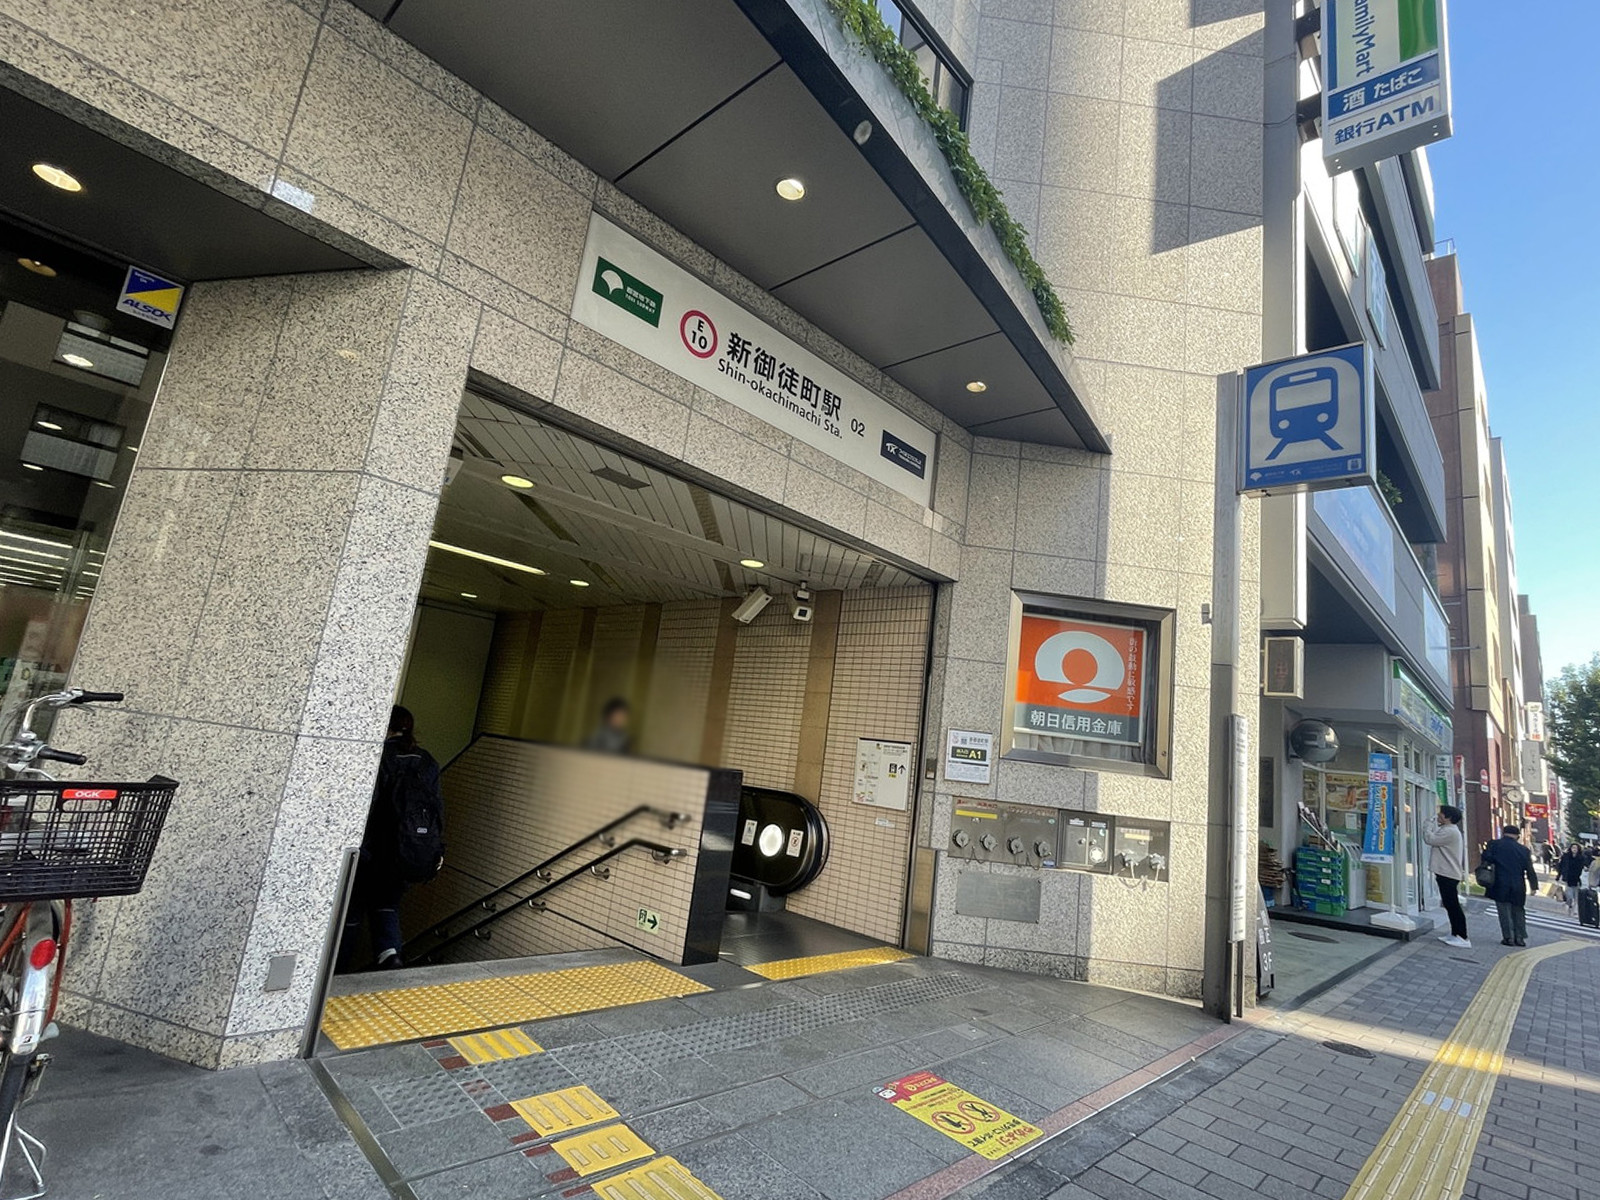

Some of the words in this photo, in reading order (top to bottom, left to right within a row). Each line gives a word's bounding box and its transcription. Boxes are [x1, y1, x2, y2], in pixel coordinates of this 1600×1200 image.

[1343, 87, 1365, 111] 酒
[1374, 67, 1423, 99] たばこ
[1334, 95, 1434, 146] 銀行ATM
[122, 298, 172, 321] ALSOK
[697, 319, 705, 332] E
[691, 330, 707, 349] 10
[727, 332, 842, 421] 新御徒町駅
[717, 358, 821, 426] Shin-okachimachi
[823, 419, 843, 439] Sta.
[851, 418, 865, 437] 02
[1031, 709, 1122, 736] 朝日信用金庫
[969, 749, 981, 759] A1
[75, 790, 103, 798] OGK
